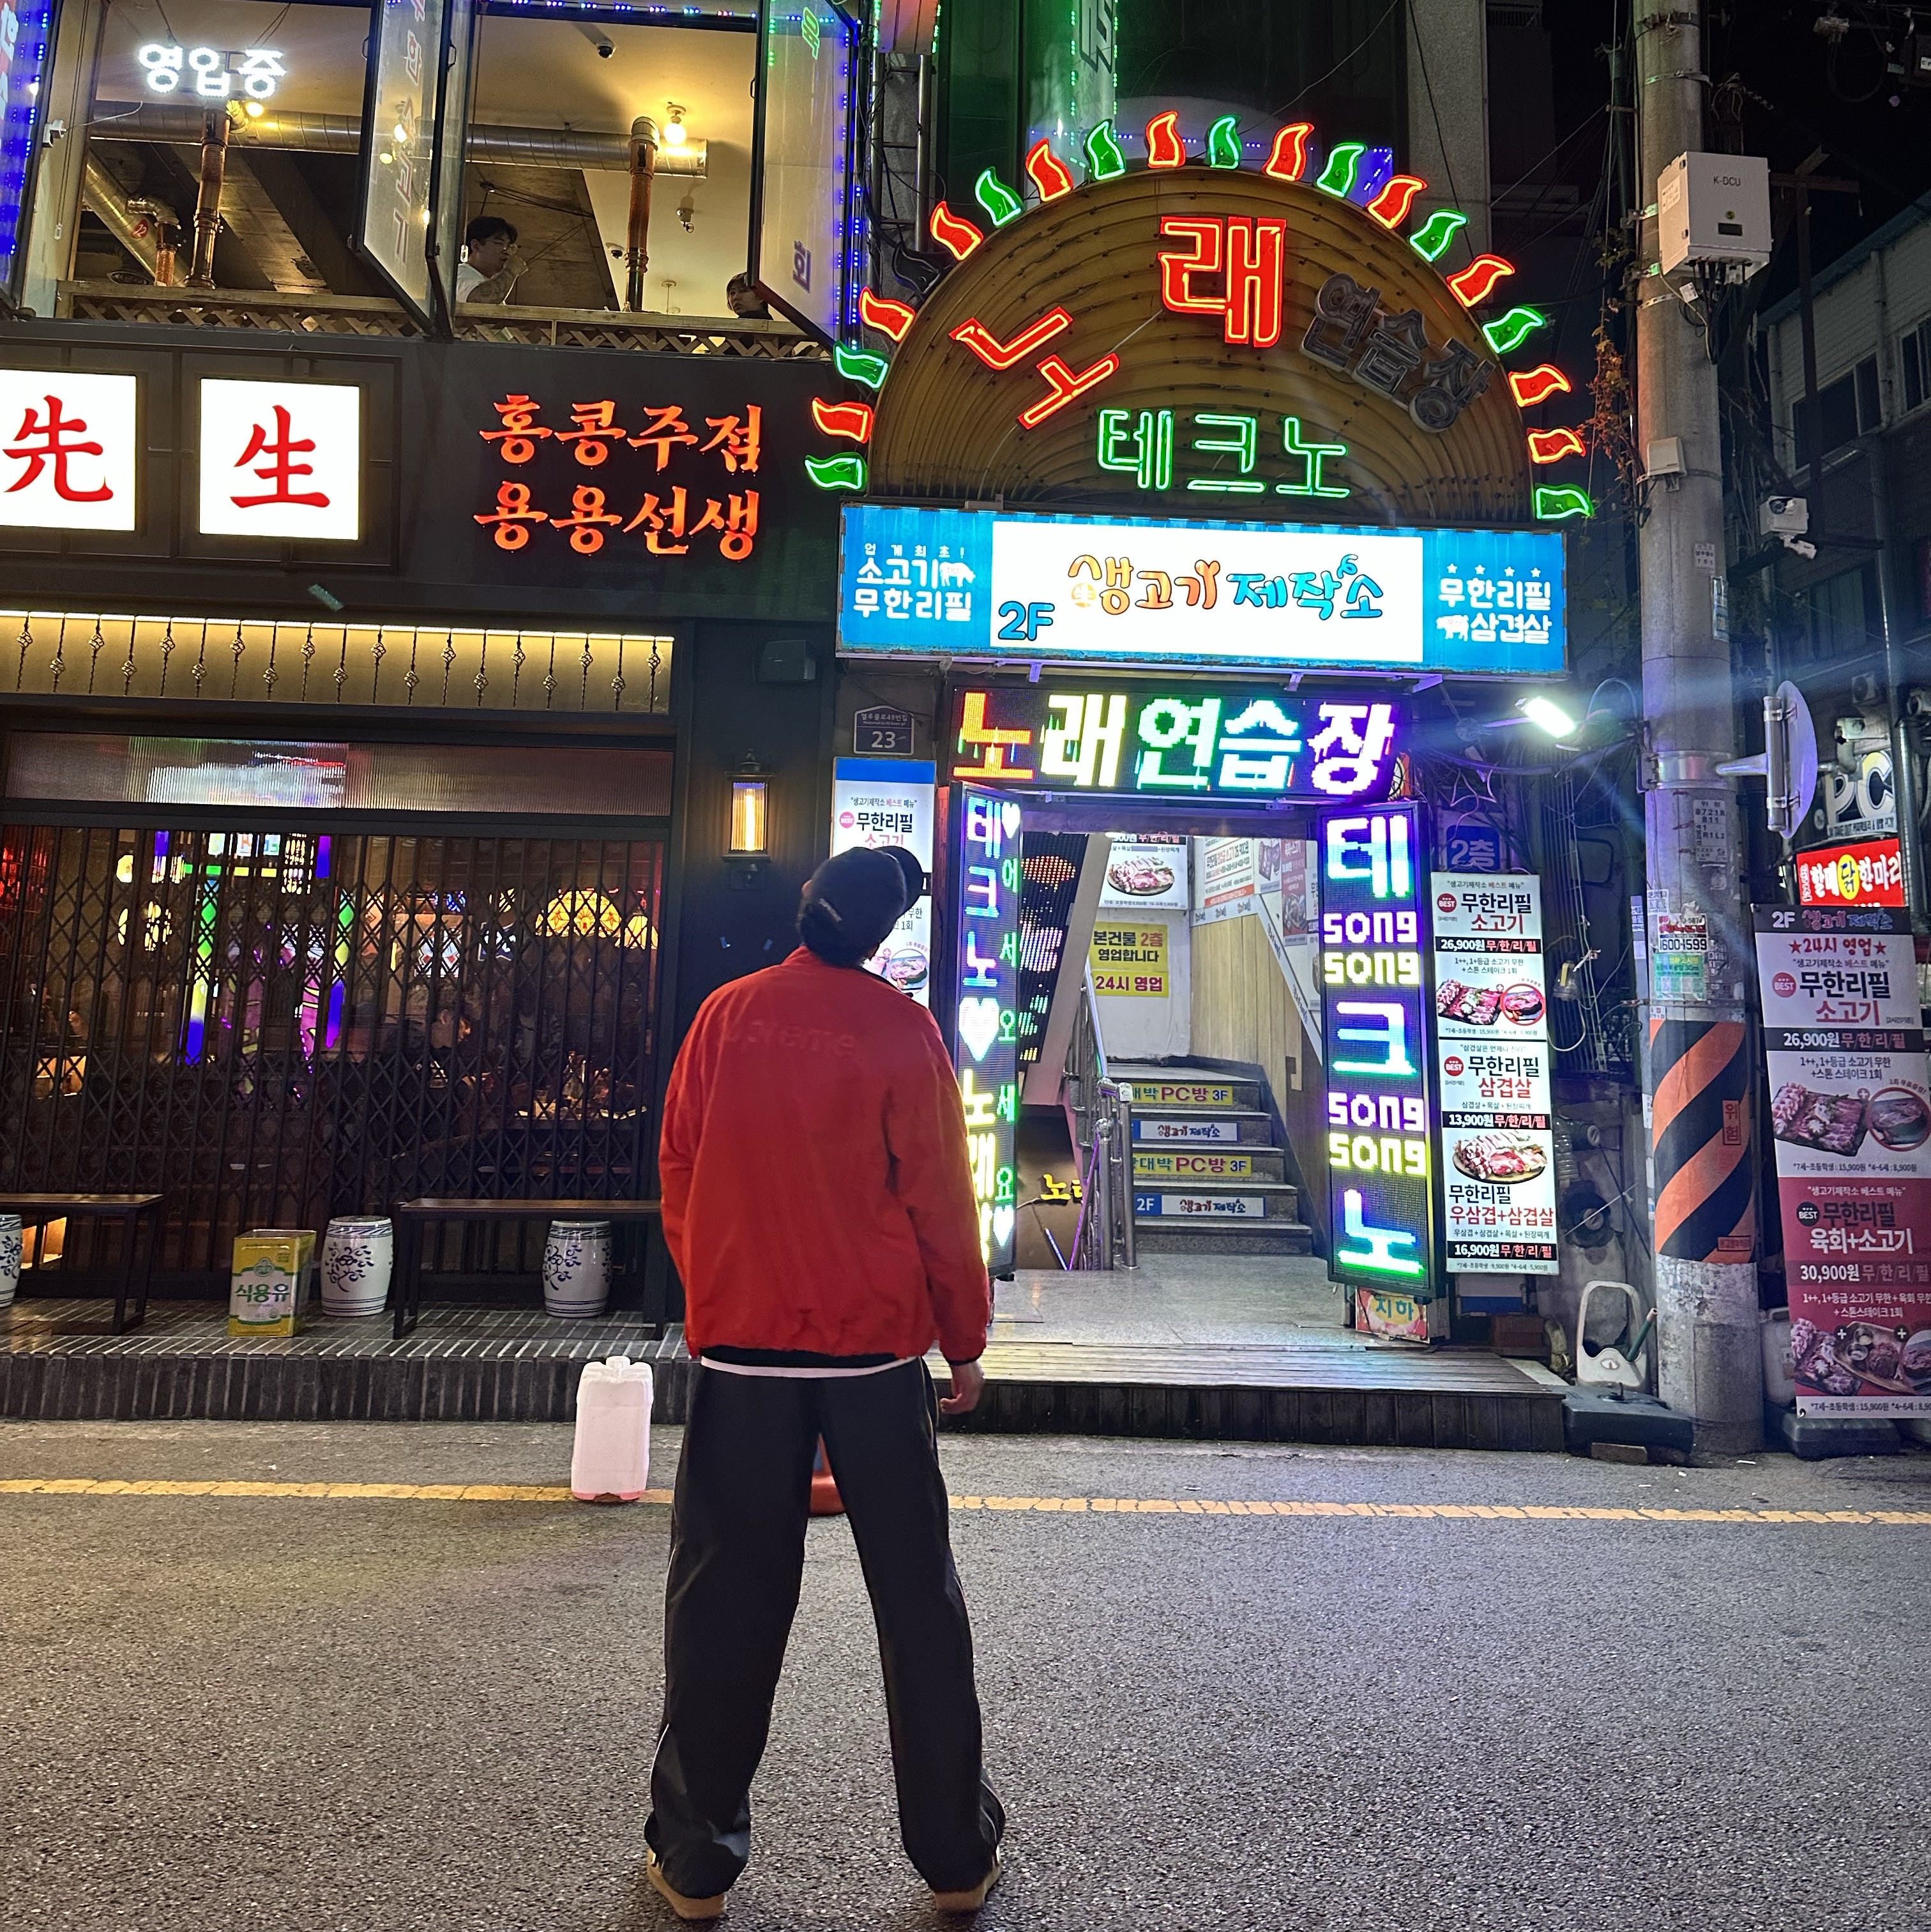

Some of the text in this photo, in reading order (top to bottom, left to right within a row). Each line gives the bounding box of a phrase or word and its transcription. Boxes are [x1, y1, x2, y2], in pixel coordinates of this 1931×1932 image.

[1713, 176, 1741, 186] K-DCU
[479, 393, 762, 473] 홍콩주점
[1097, 409, 1350, 499] 테크노
[473, 480, 760, 561] 용용선생
[856, 557, 939, 589] 소고기
[1068, 554, 1384, 620] 생고기 제작소
[1438, 577, 1552, 611] 무한리필
[853, 588, 972, 622] 무한리필
[997, 600, 1056, 641] 2F
[1471, 612, 1552, 644] 삼겹살
[871, 731, 896, 749] 23
[952, 691, 1397, 796] 노래연습장
[1825, 750, 1896, 826] PC
[856, 812, 913, 833] 무한리필
[1327, 815, 1409, 898] 테
[1451, 839, 1496, 867] 2층
[962, 796, 1001, 987] 테크노
[1439, 900, 1456, 908] BEST
[1461, 893, 1532, 914] 무한리필
[1324, 911, 1418, 943] song
[1471, 914, 1524, 934] 소고기
[1771, 911, 1796, 928] 2F
[1801, 909, 1846, 931] 생고기
[1093, 931, 1163, 947] 본건물 2층
[1441, 939, 1485, 952] 26,900원
[1660, 938, 1708, 950] 1600-1599
[1803, 938, 1872, 956] 24시 영업
[1098, 948, 1160, 962] 영업합니다
[1324, 952, 1420, 984] song
[1095, 975, 1162, 992] 24시 영업
[1774, 981, 1795, 991] BEST
[1799, 970, 1891, 999] 무한리필
[1815, 1000, 1880, 1026] 소고기
[1333, 1001, 1417, 1076] 크
[1783, 1031, 1840, 1050] 26,900원
[1468, 1056, 1540, 1077] 무한리필
[1848, 1058, 1873, 1067] 소고기
[1161, 1086, 1209, 1102] PC방
[1213, 1090, 1229, 1101] 3F
[1478, 1077, 1532, 1099] 삼겹살
[1328, 1092, 1424, 1132] song
[1449, 1114, 1494, 1128] 13,900원
[1725, 1104, 1739, 1141] 위험
[1157, 1123, 1220, 1138] 생고기 제작소
[1175, 1157, 1227, 1173] PC방
[1230, 1160, 1246, 1172] 3F
[1329, 1133, 1427, 1175] song
[1137, 1198, 1155, 1212] 2F
[1179, 1198, 1246, 1213] 생고기 제작소
[1449, 1184, 1511, 1205] 무한리필
[1450, 1205, 1554, 1227] 우삼겹+삼겹살
[1798, 1210, 1818, 1220] BEST
[1822, 1201, 1896, 1228] 무한리필
[1338, 1189, 1424, 1275] 노
[1810, 1227, 1913, 1255] 육회+소고기
[1455, 1244, 1500, 1258] 16,900원
[1800, 1263, 1860, 1283] 30,900원
[234, 1283, 290, 1303] 식용유
[1849, 1293, 1873, 1304] 소고기
[1375, 1297, 1414, 1321] 지하
